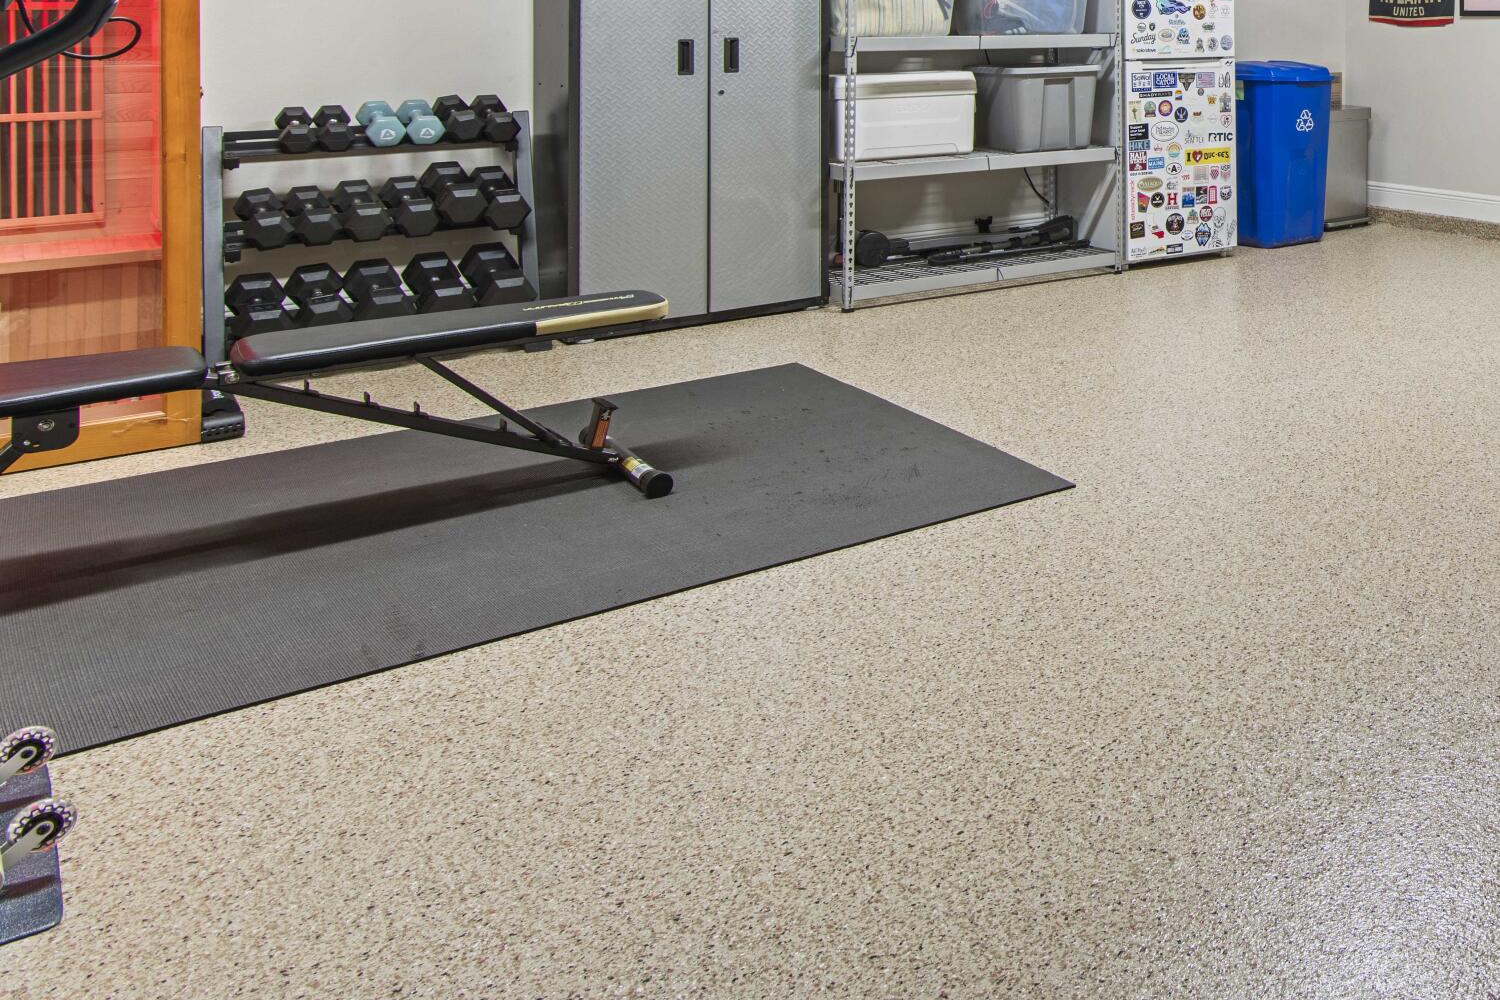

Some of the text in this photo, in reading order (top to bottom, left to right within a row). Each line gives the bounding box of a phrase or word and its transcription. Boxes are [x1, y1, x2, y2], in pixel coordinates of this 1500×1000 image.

[1393, 6, 1425, 17] UNITED
[1131, 33, 1156, 44] Sunday
[1208, 132, 1233, 142] RTIC
[1186, 152, 1191, 162] I
[1171, 164, 1177, 173] A
[1167, 192, 1178, 205] H
